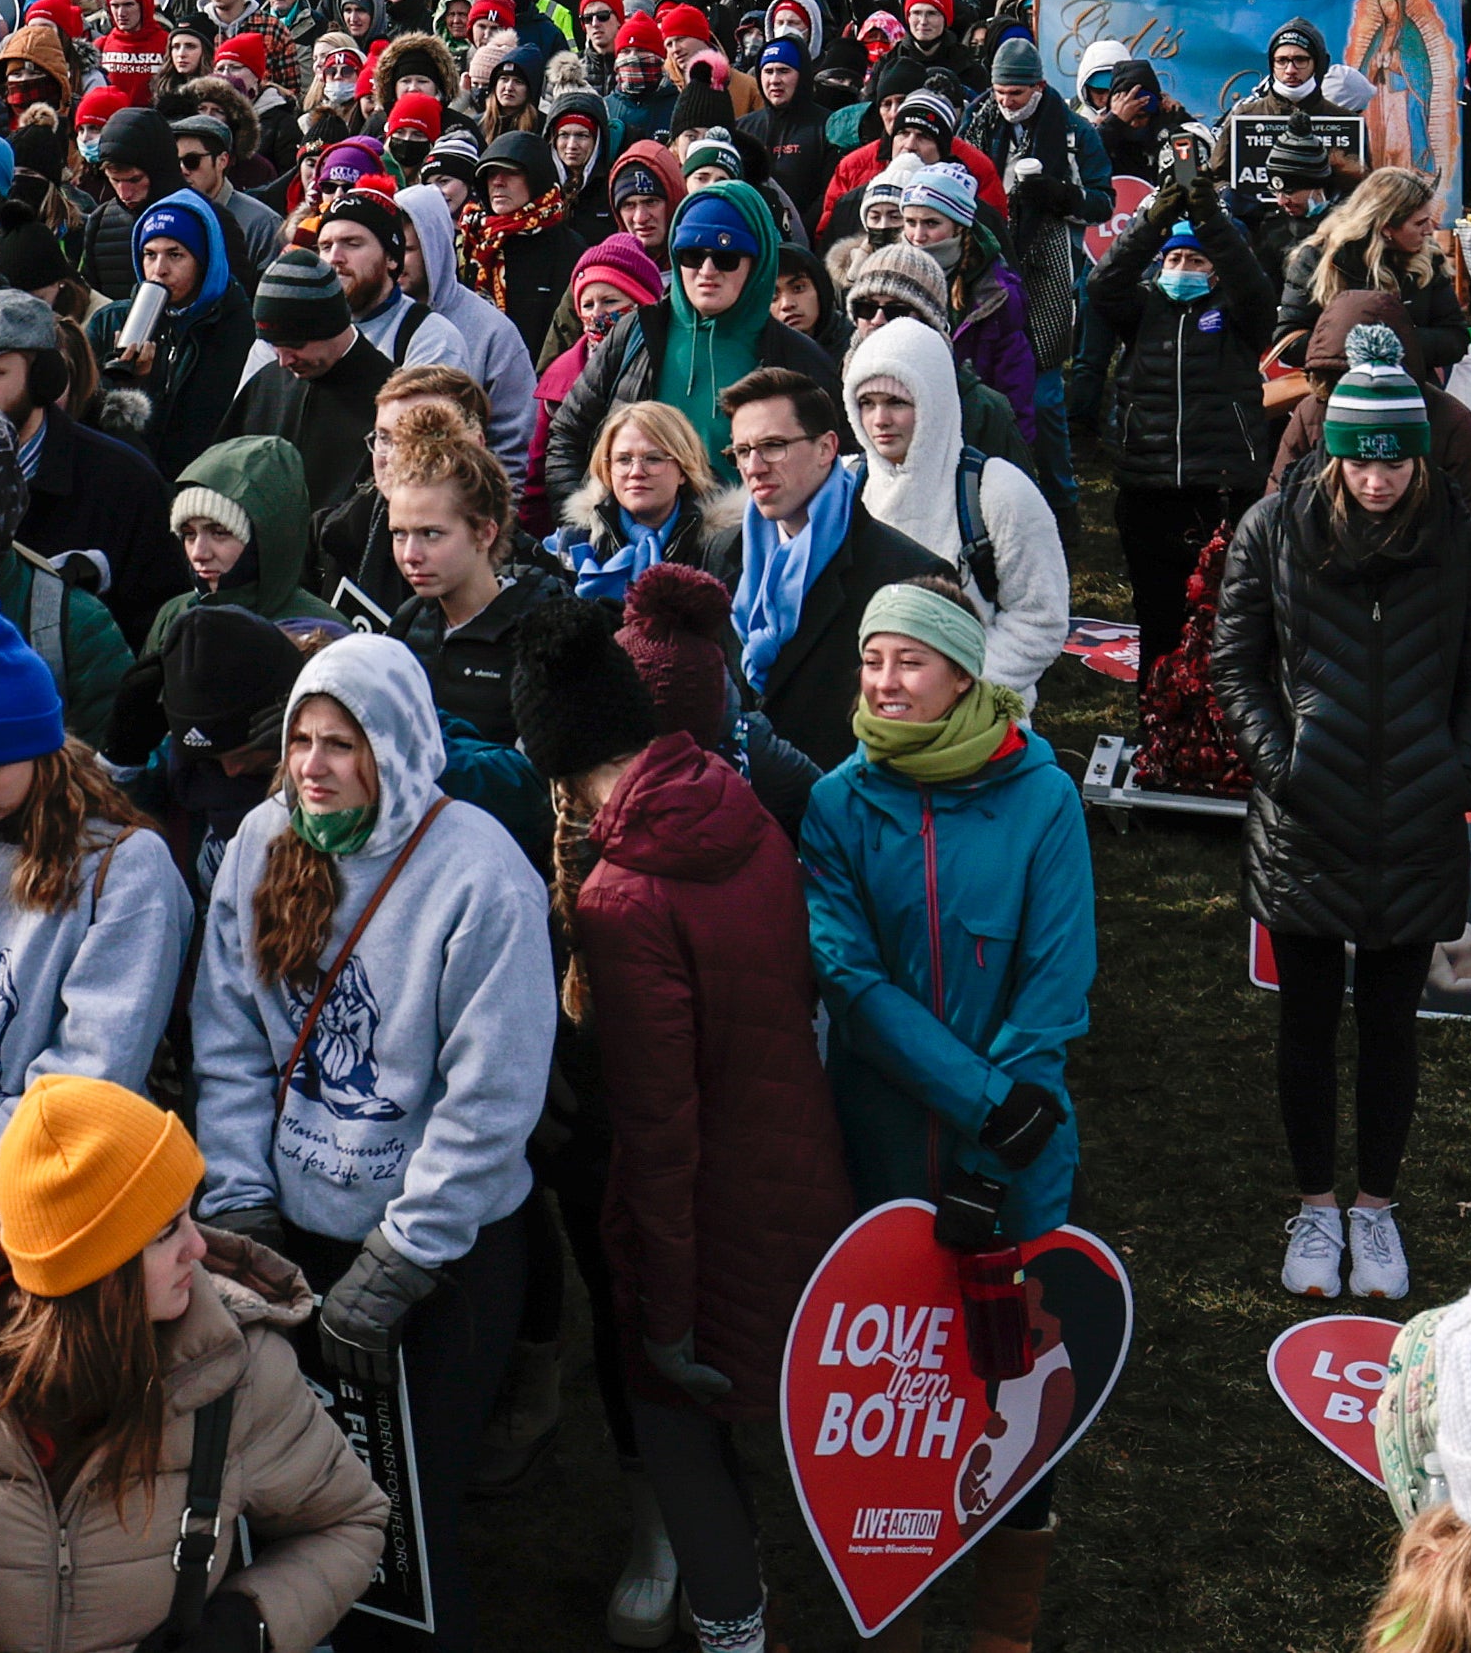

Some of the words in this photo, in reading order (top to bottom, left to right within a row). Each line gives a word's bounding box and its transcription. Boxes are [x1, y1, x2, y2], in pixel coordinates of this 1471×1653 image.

[488, 10, 498, 21] N
[102, 52, 164, 64] NEBRASKA
[335, 53, 345, 65] N
[1245, 135, 1273, 146] THE
[1336, 135, 1350, 147] IS
[282, 1114, 329, 1145] Maria
[302, 1155, 327, 1172] for
[330, 1159, 360, 1186] Life
[819, 1301, 954, 1368] LOVE
[873, 1349, 952, 1406] them
[814, 1389, 966, 1460] BOTH
[852, 1507, 888, 1541] LIVE
[888, 1508, 942, 1541] ACTION
[848, 1542, 883, 1555] Instagram:
